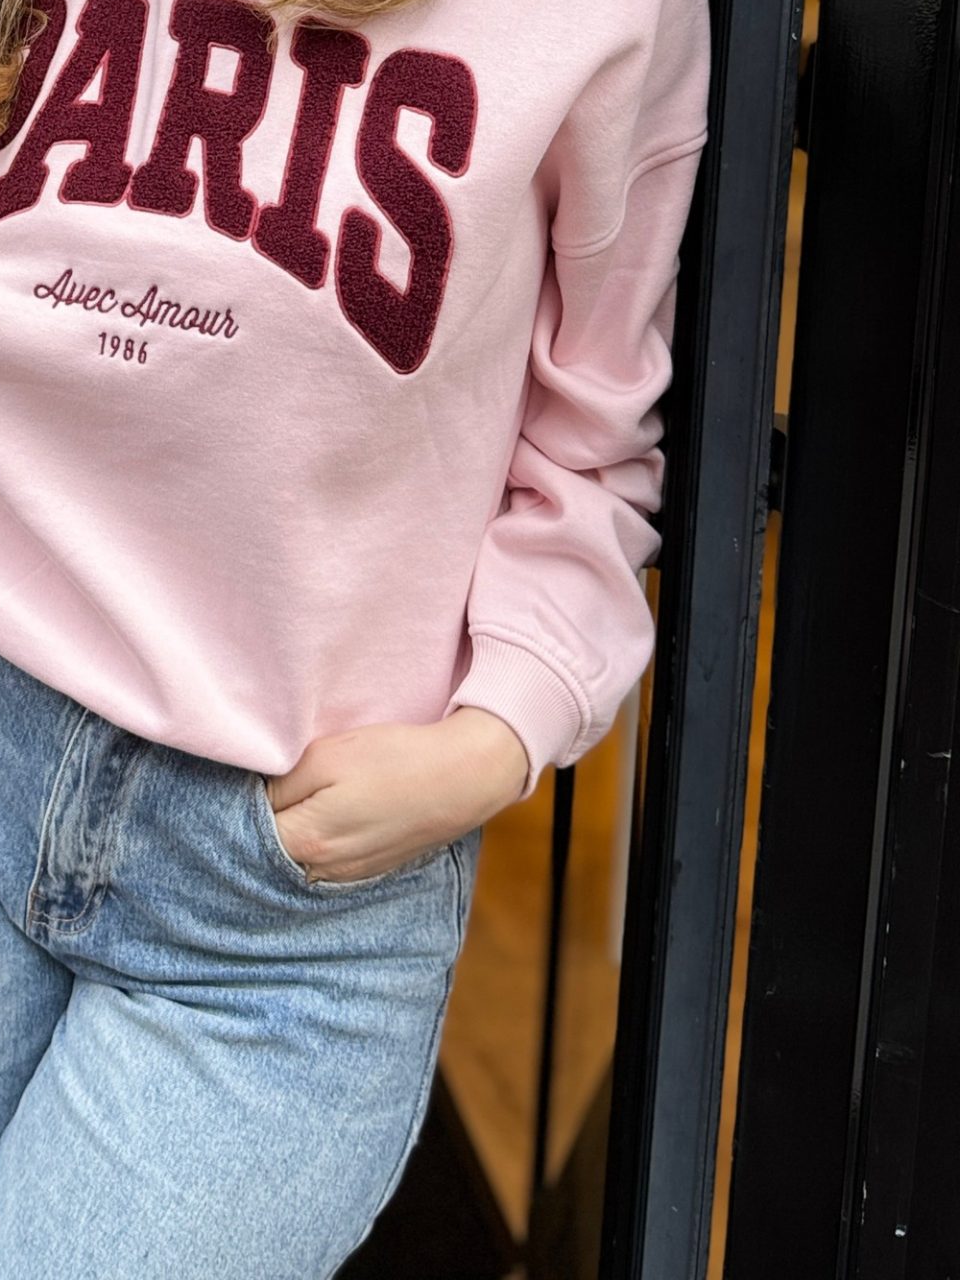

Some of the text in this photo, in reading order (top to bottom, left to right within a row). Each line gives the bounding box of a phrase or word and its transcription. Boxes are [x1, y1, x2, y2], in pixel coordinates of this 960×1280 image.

[33, 267, 240, 339] Avec Amour
[97, 331, 149, 365] 1986
